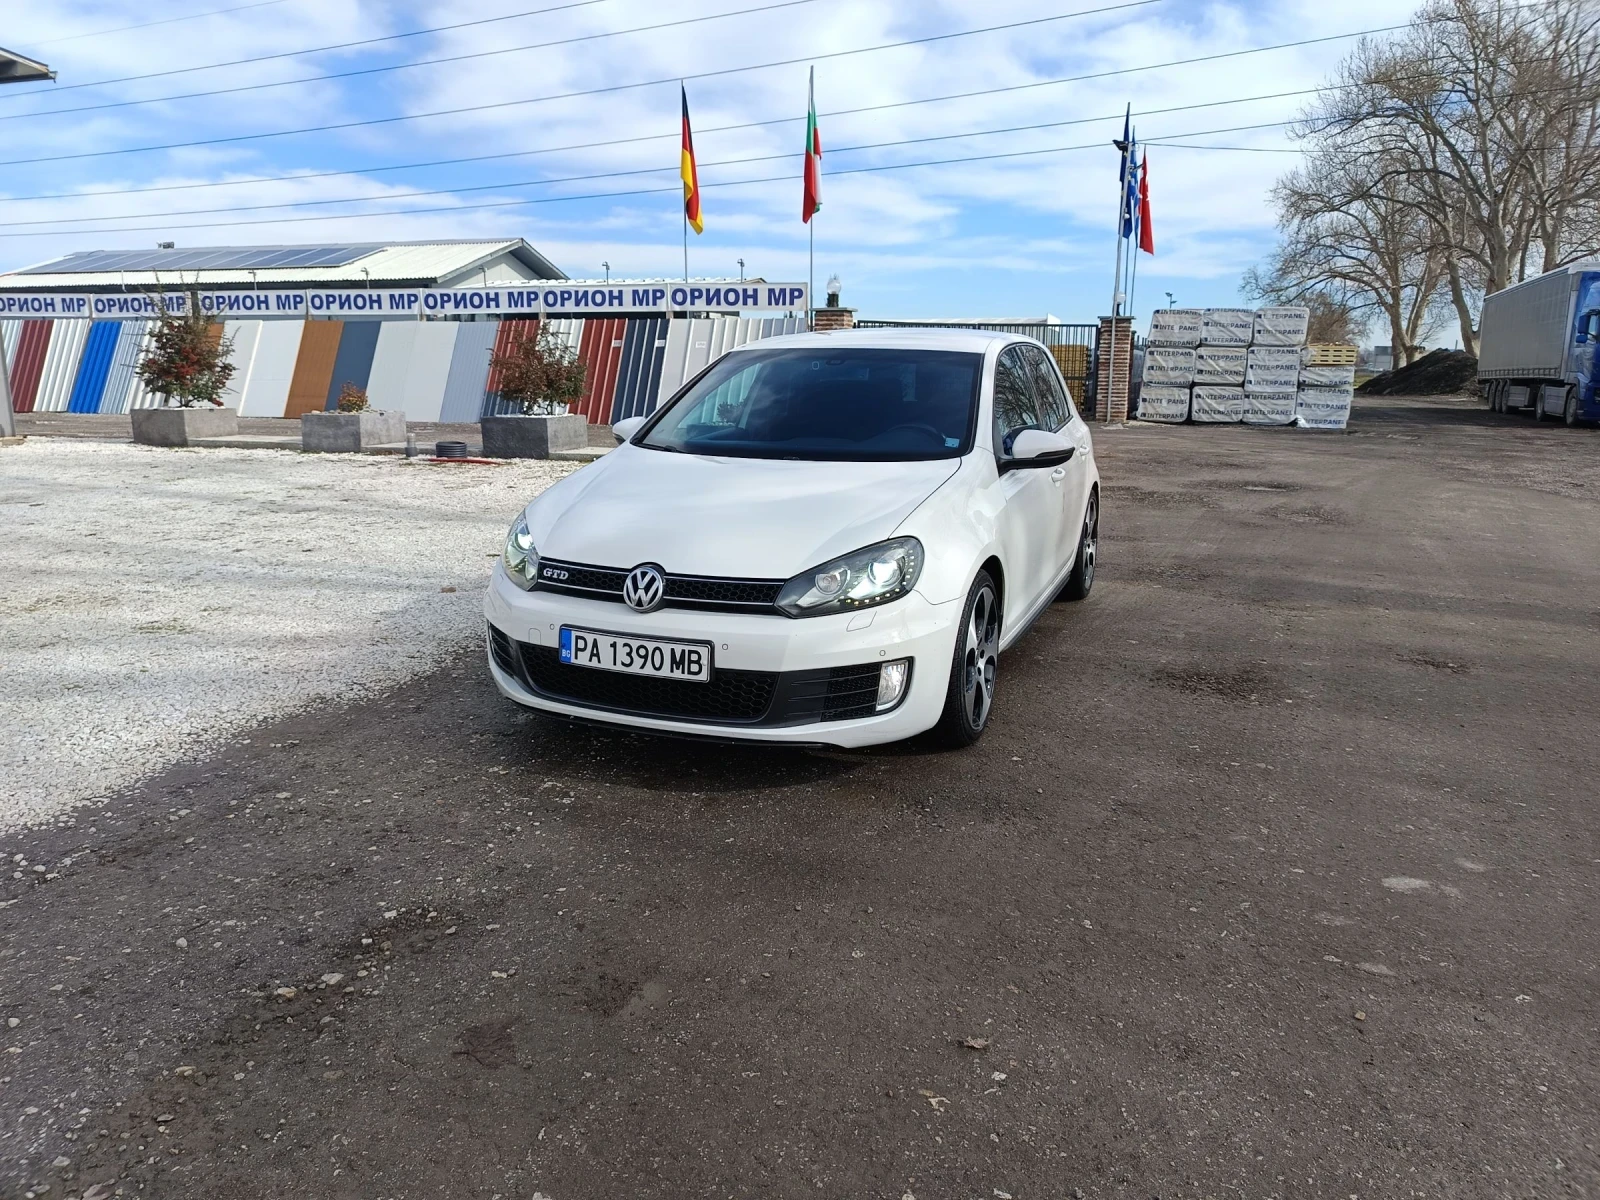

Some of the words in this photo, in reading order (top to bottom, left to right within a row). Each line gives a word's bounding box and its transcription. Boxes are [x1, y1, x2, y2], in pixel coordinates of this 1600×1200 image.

[94, 297, 155, 313] ОРИОН
[201, 294, 269, 311] ОРИОН
[276, 293, 304, 310] МР
[311, 293, 381, 310] ОРИОН
[390, 293, 419, 310] МР
[424, 292, 500, 310] ОРИОН
[508, 291, 539, 309] МР
[543, 290, 623, 308] ОРИОН
[632, 289, 665, 307] МР
[671, 288, 758, 306] ОРИОН
[767, 287, 803, 306] МР
[62, 298, 86, 313] МР
[543, 568, 569, 580] GTD
[561, 649, 571, 658] BG
[574, 635, 601, 664] PA
[609, 640, 665, 672] 1390
[670, 647, 703, 676] MB
